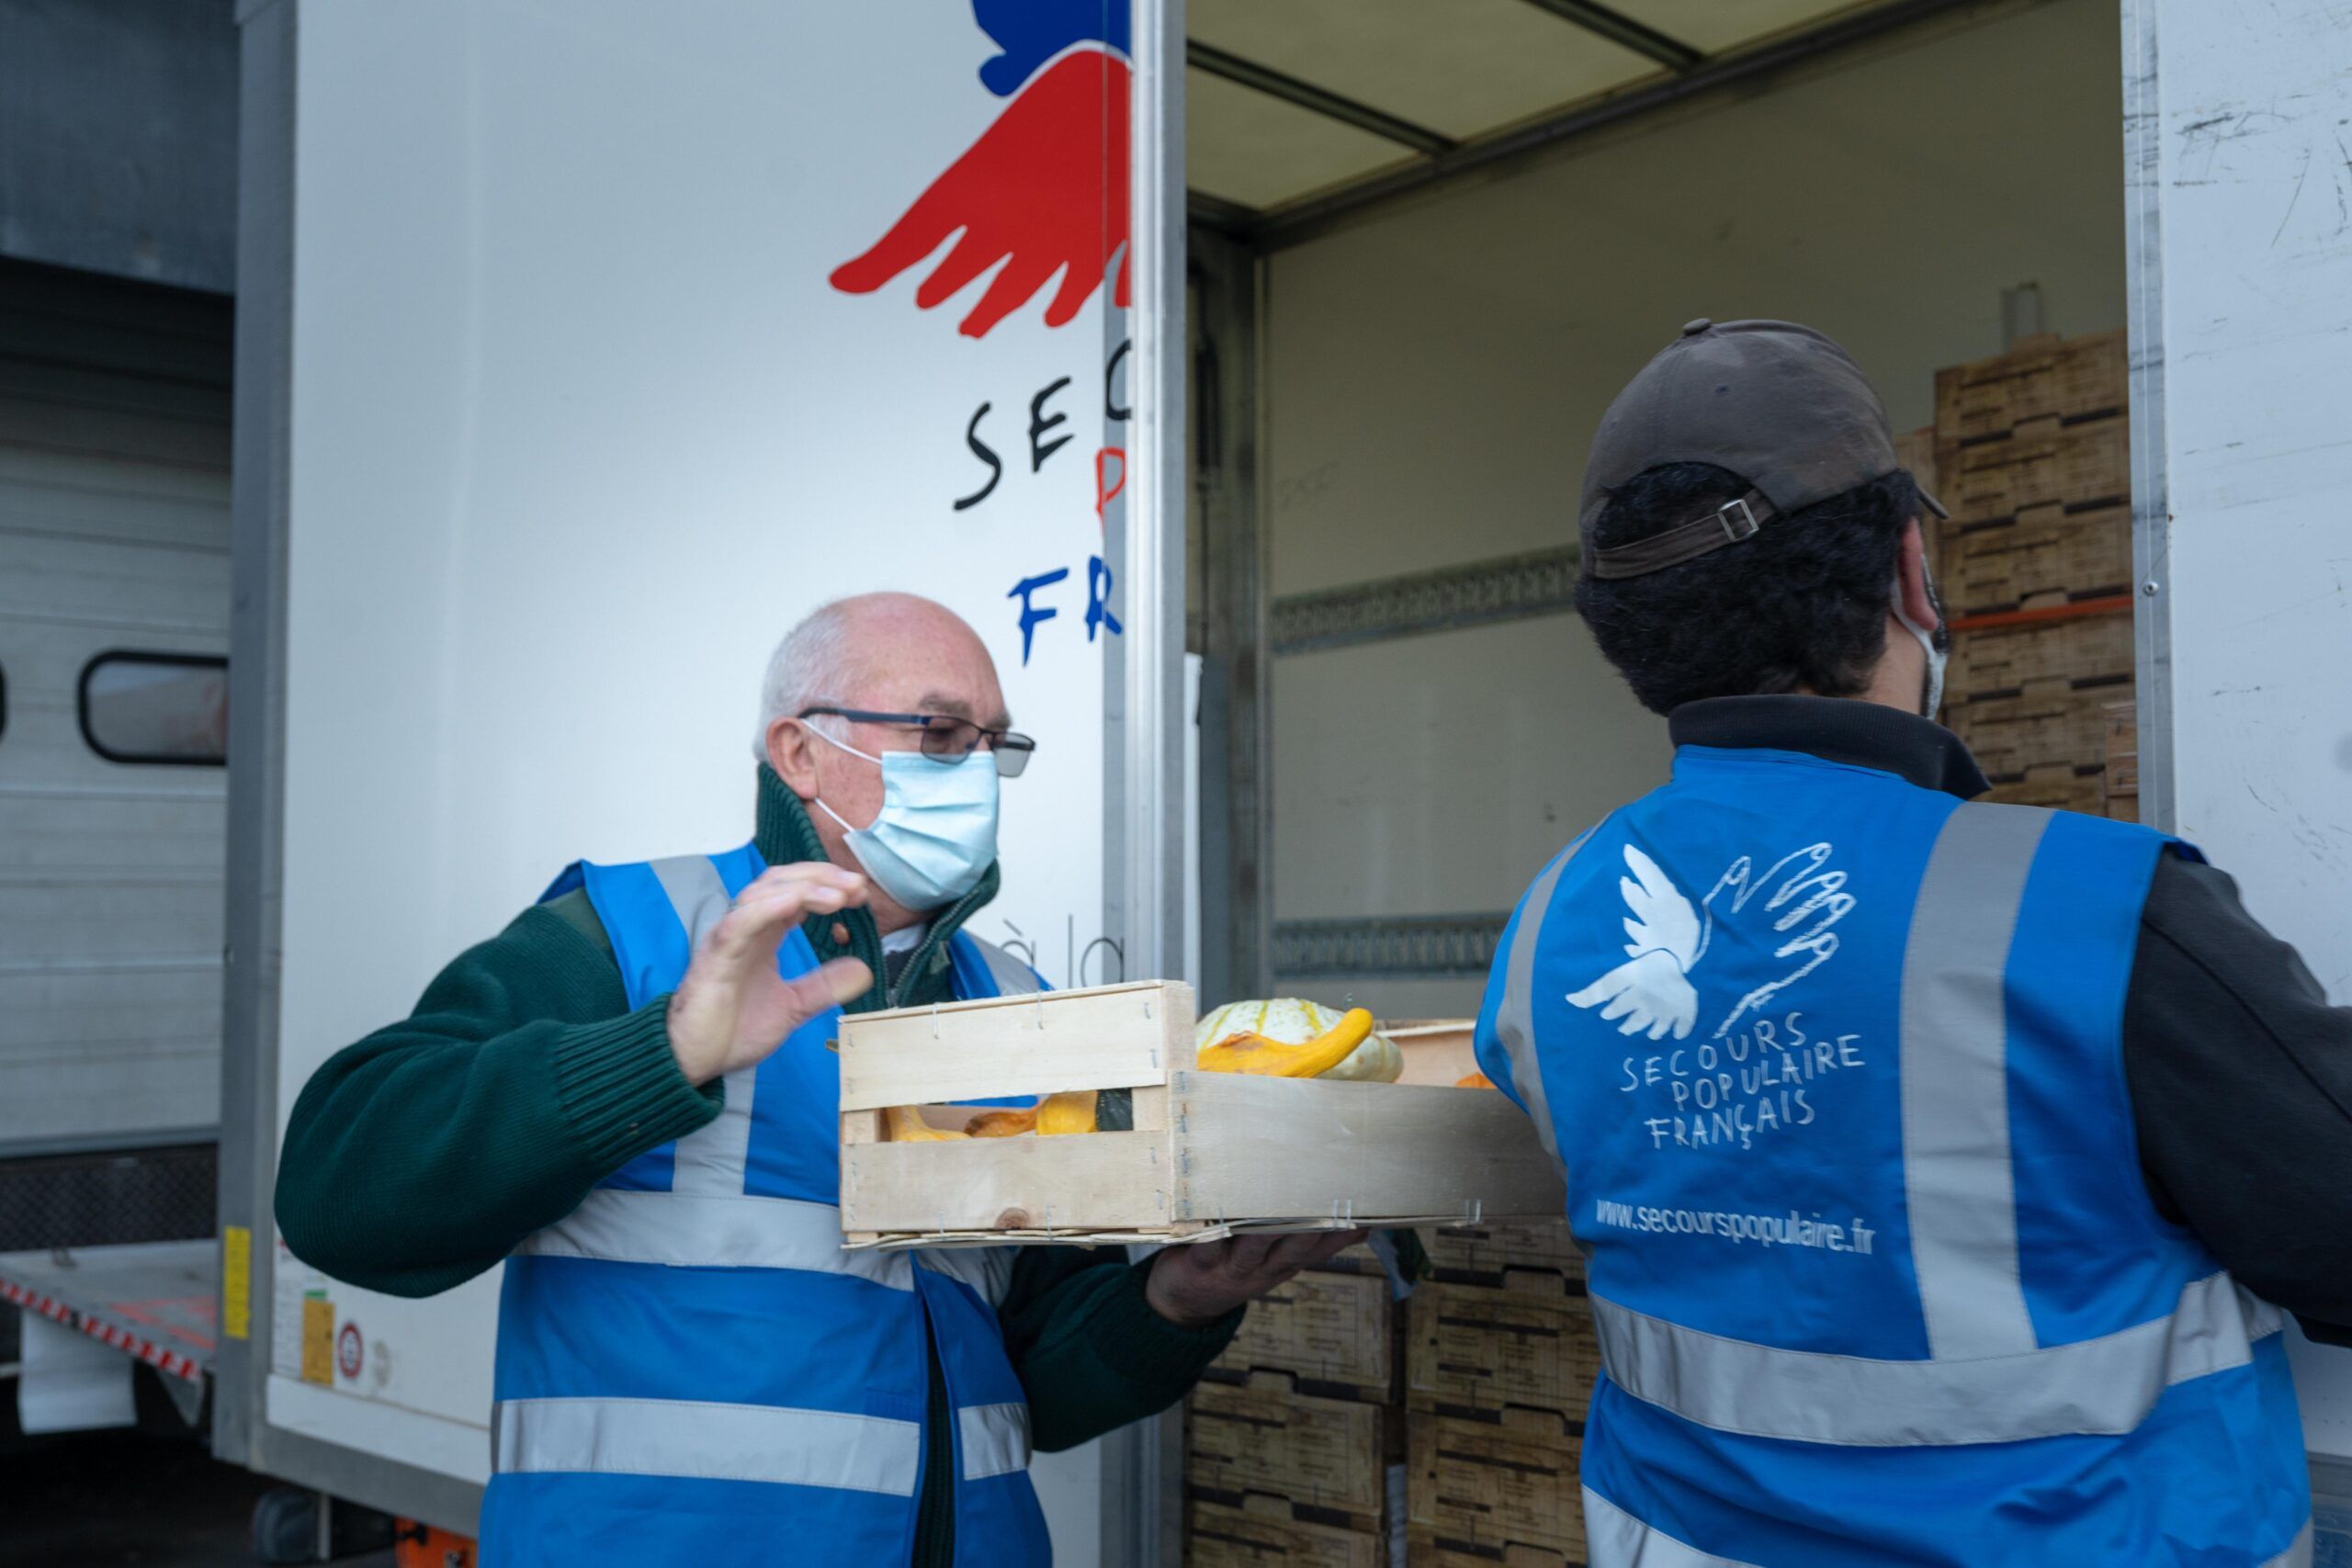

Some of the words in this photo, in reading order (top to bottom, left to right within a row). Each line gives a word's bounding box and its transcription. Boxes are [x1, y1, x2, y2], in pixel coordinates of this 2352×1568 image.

[1620, 1011, 1807, 1092] SECOURS
[1671, 1033, 1865, 1111] POPULAIRE
[1643, 1089, 1815, 1150] FRANÇAIS
[1596, 1198, 1876, 1255] www.secourspopulaire.fr
